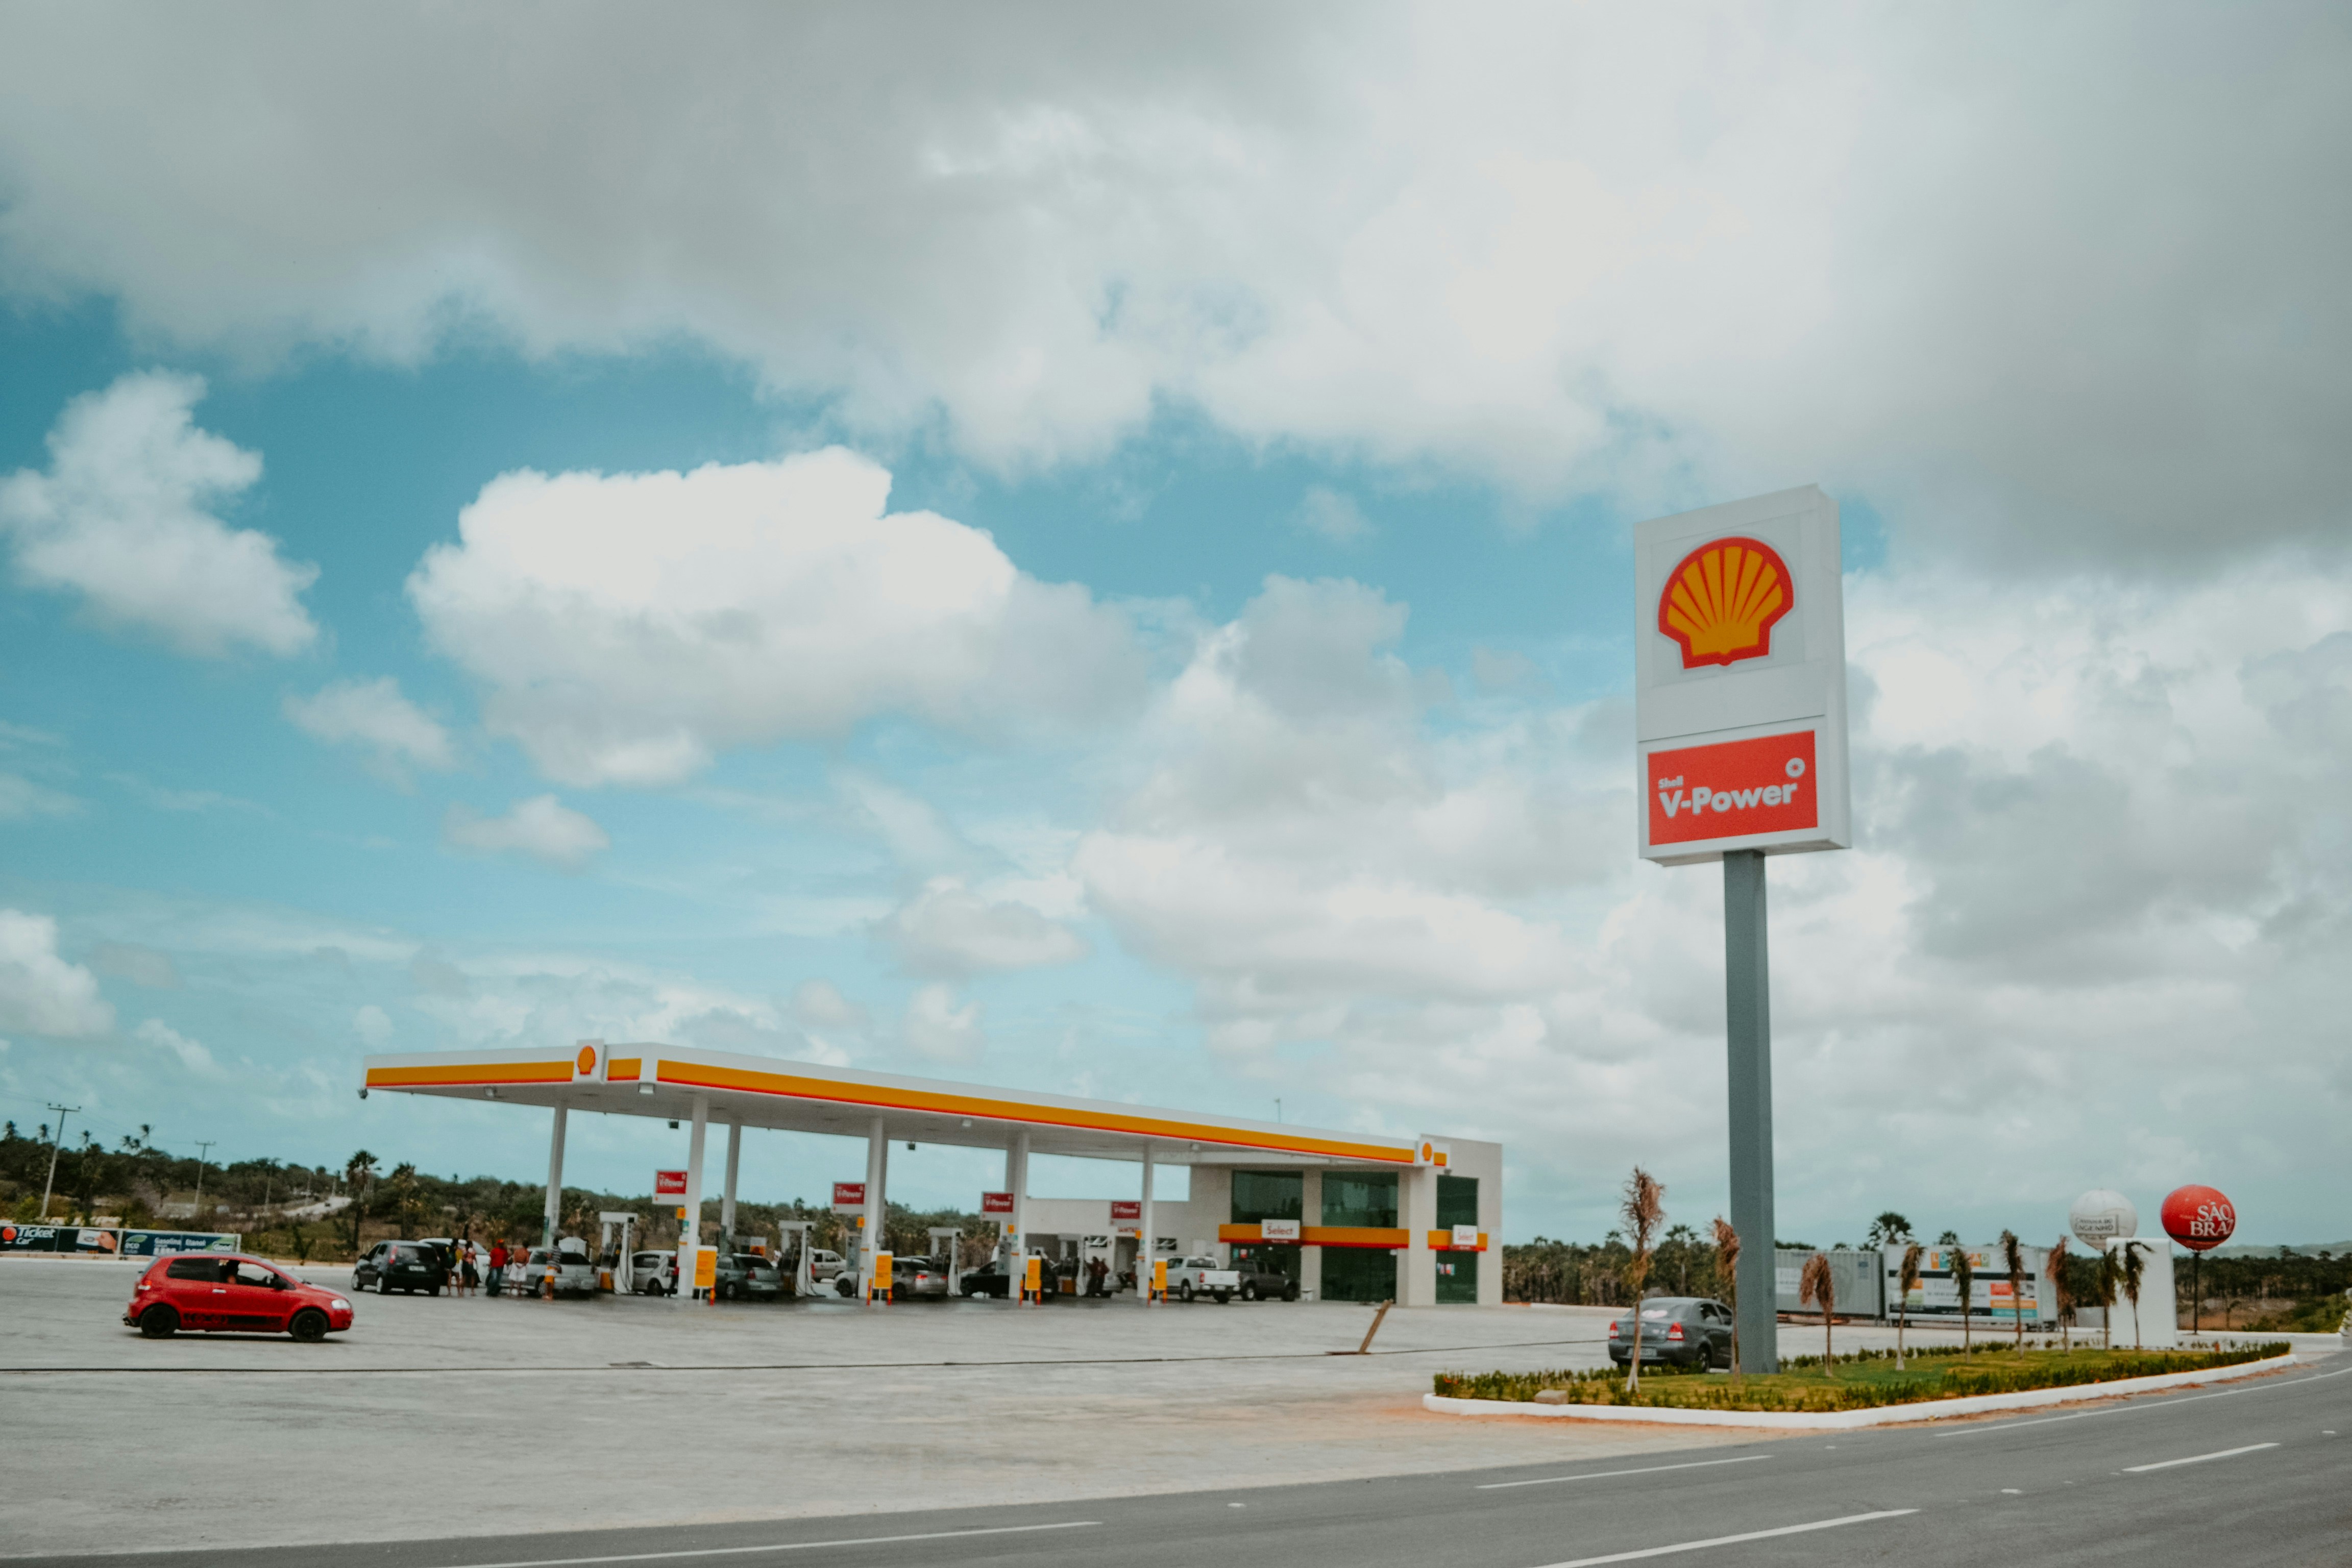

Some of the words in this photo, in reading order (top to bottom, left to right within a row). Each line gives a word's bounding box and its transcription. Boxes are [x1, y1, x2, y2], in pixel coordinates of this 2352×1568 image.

[1658, 775, 1683, 789] Shell
[1659, 783, 1797, 818] V-Power
[2197, 1202, 2232, 1221] SÃO
[18, 1227, 56, 1238] Ticket
[1267, 1226, 1293, 1234] Select
[2190, 1219, 2234, 1236] BRAZ
